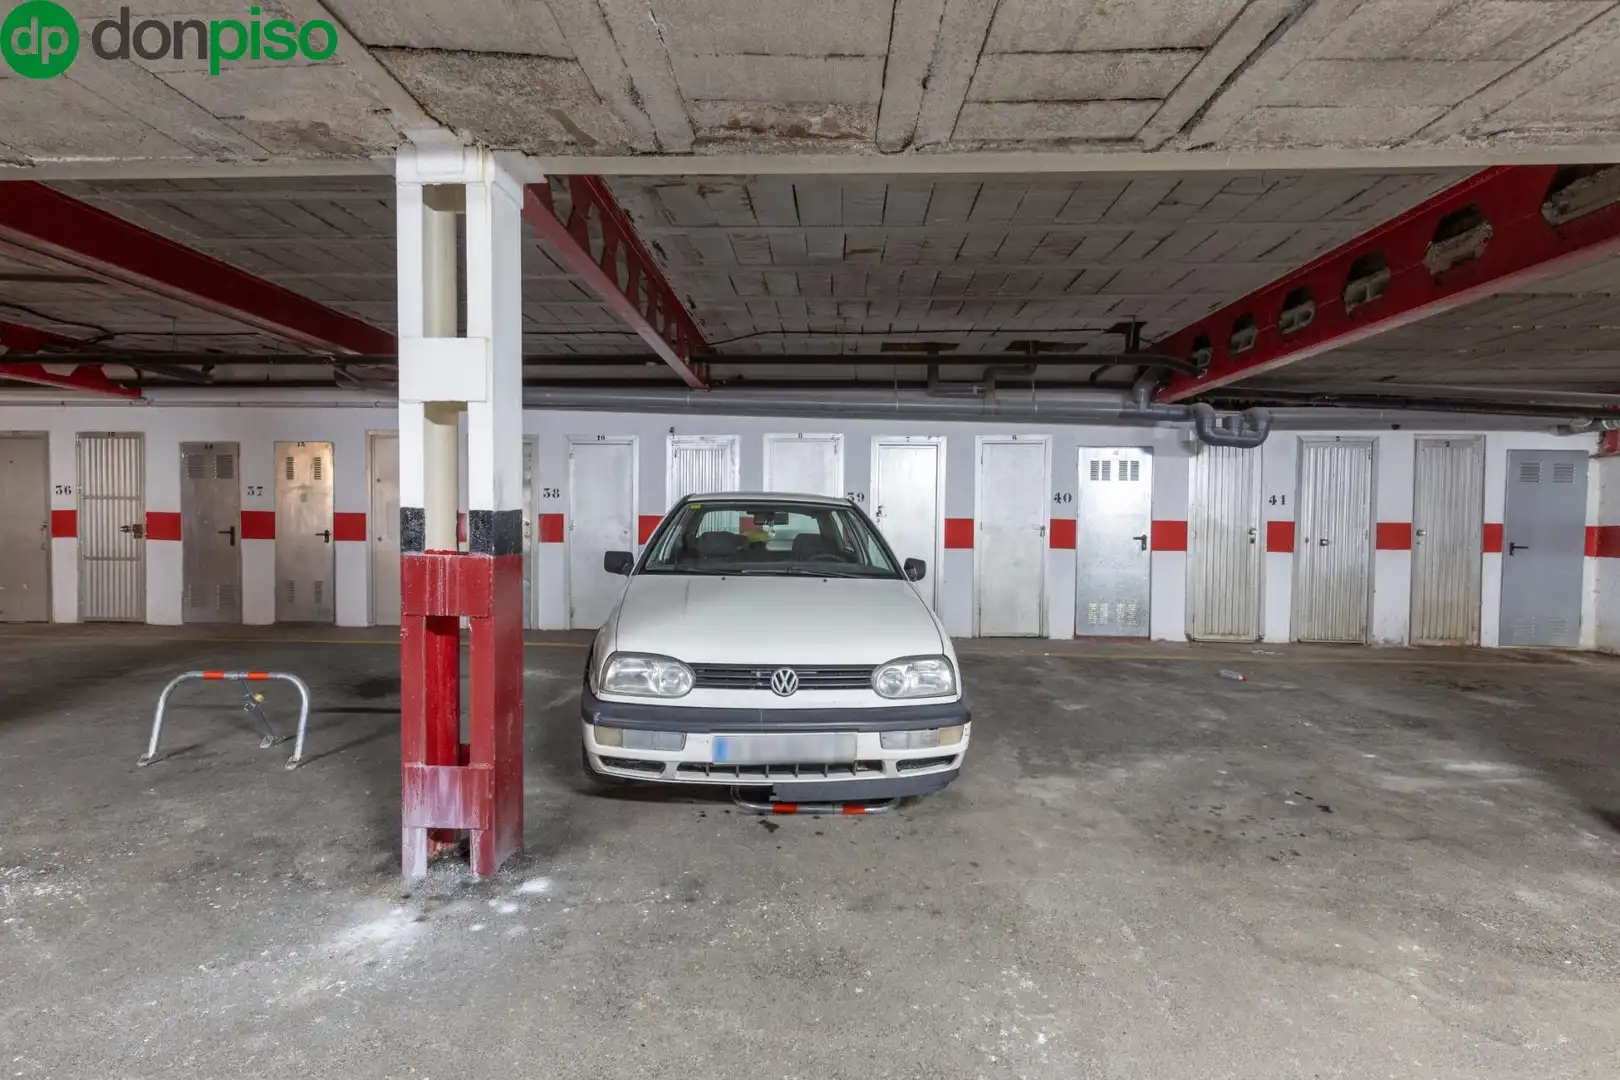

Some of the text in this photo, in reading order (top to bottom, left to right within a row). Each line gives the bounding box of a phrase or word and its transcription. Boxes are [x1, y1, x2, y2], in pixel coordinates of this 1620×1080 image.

[55, 485, 72, 495] 36
[247, 486, 264, 497] 37
[543, 488, 560, 498] 38
[1053, 492, 1072, 504] 40
[1268, 494, 1286, 506] 41
[771, 667, 799, 697] VW
